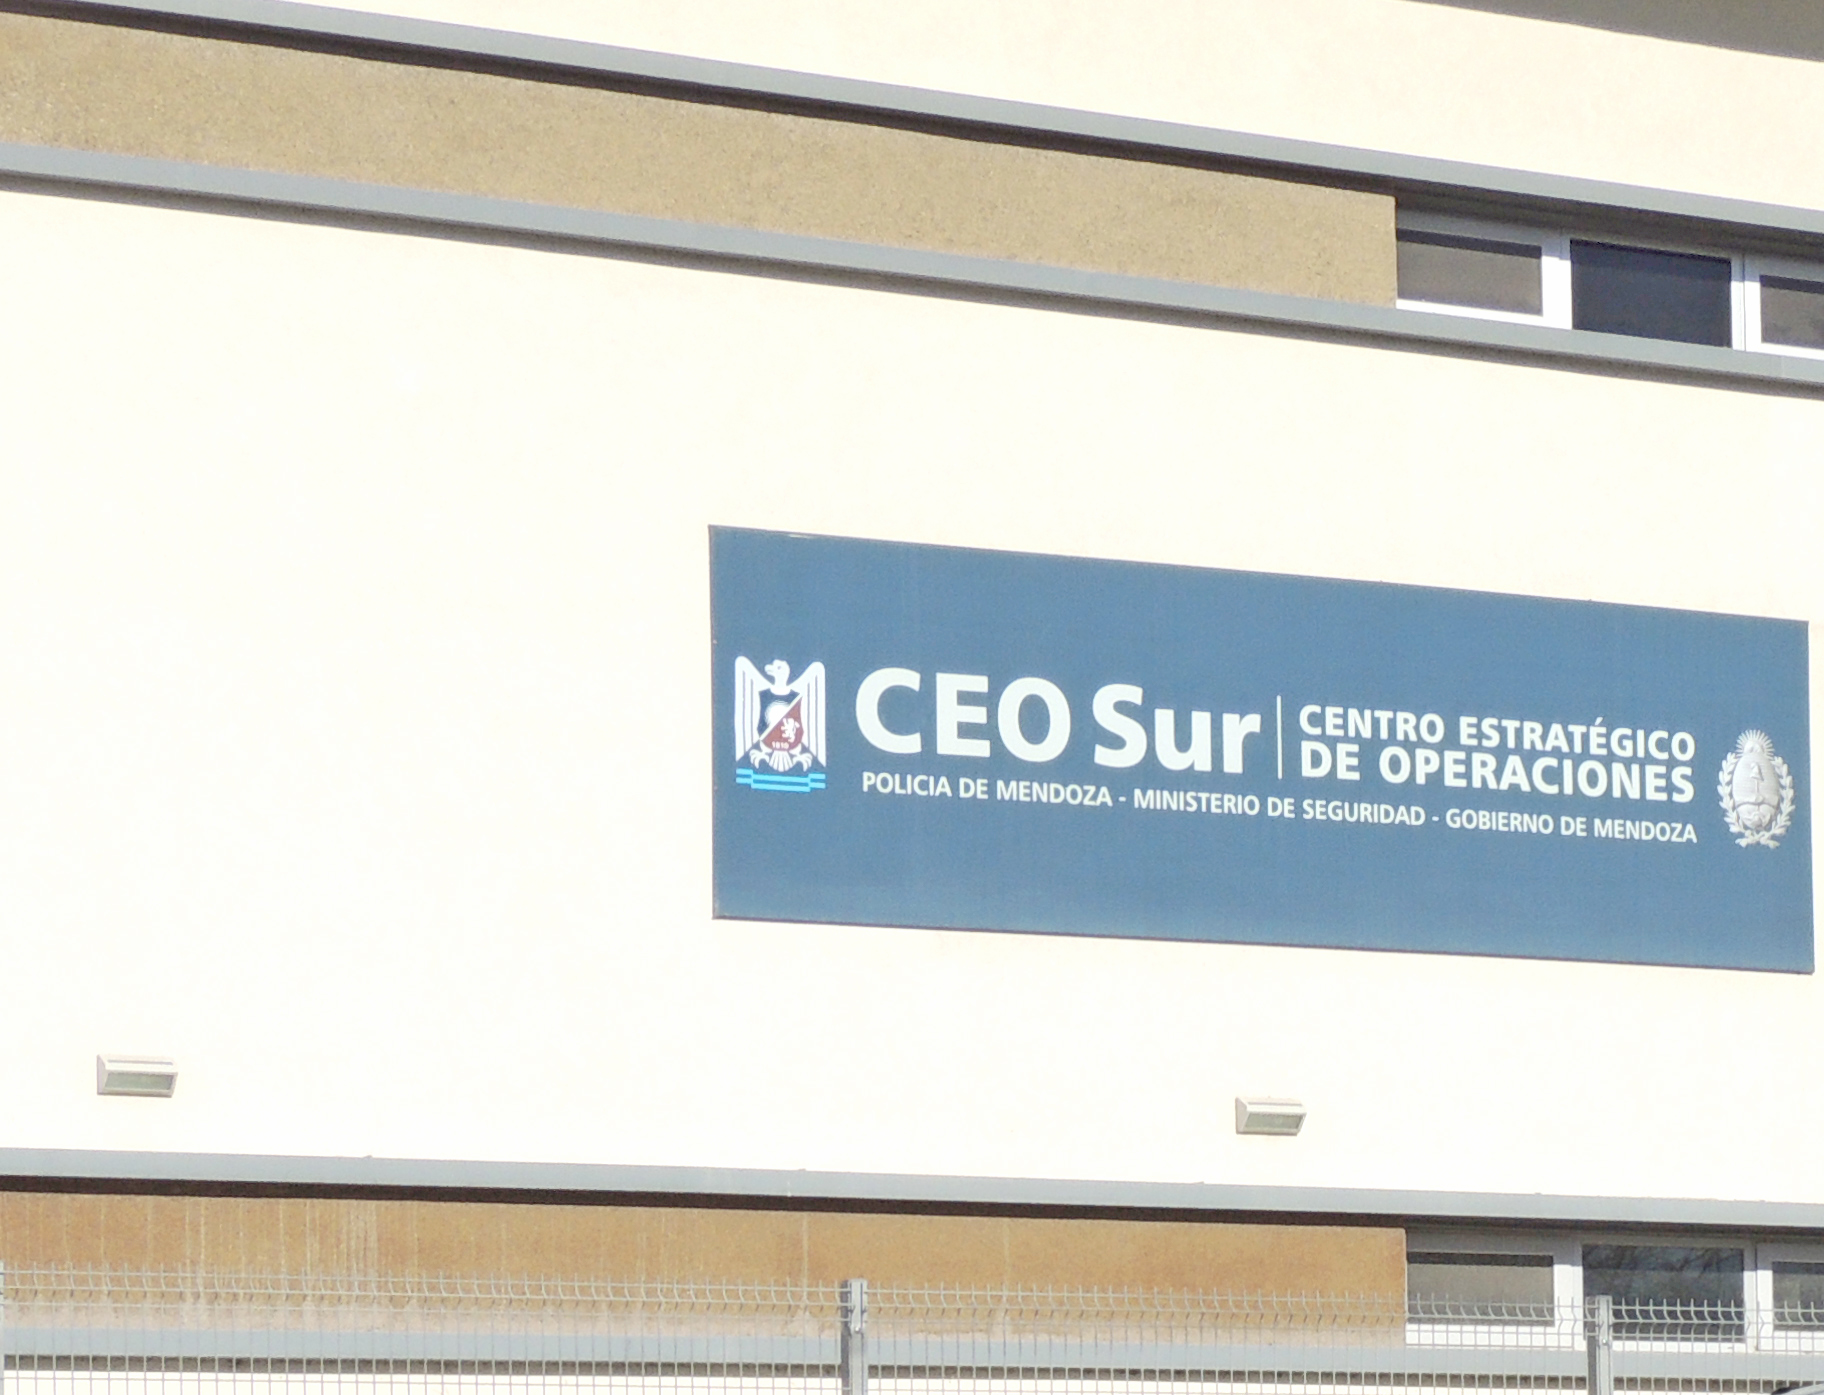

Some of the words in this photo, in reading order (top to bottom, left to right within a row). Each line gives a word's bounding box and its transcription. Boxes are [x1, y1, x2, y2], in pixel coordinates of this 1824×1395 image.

[855, 667, 1071, 763] CEO
[1092, 683, 1261, 774] Sur
[1300, 704, 1444, 743] CENTRO
[1460, 716, 1696, 761] ESTRATÉGICO
[1301, 741, 1361, 781] DE
[1379, 746, 1695, 803] OPERACIONES
[862, 771, 952, 797] POLICIA
[959, 777, 989, 799] DE
[997, 780, 1113, 808] MENDOZA
[1134, 789, 1260, 816] MINISTERIO
[1268, 797, 1296, 819] DE
[1303, 798, 1427, 827] SEGURIDAD
[1446, 808, 1554, 835] GOBIERNO
[1560, 816, 1587, 837] DE
[1594, 818, 1697, 844] MENDOZA
